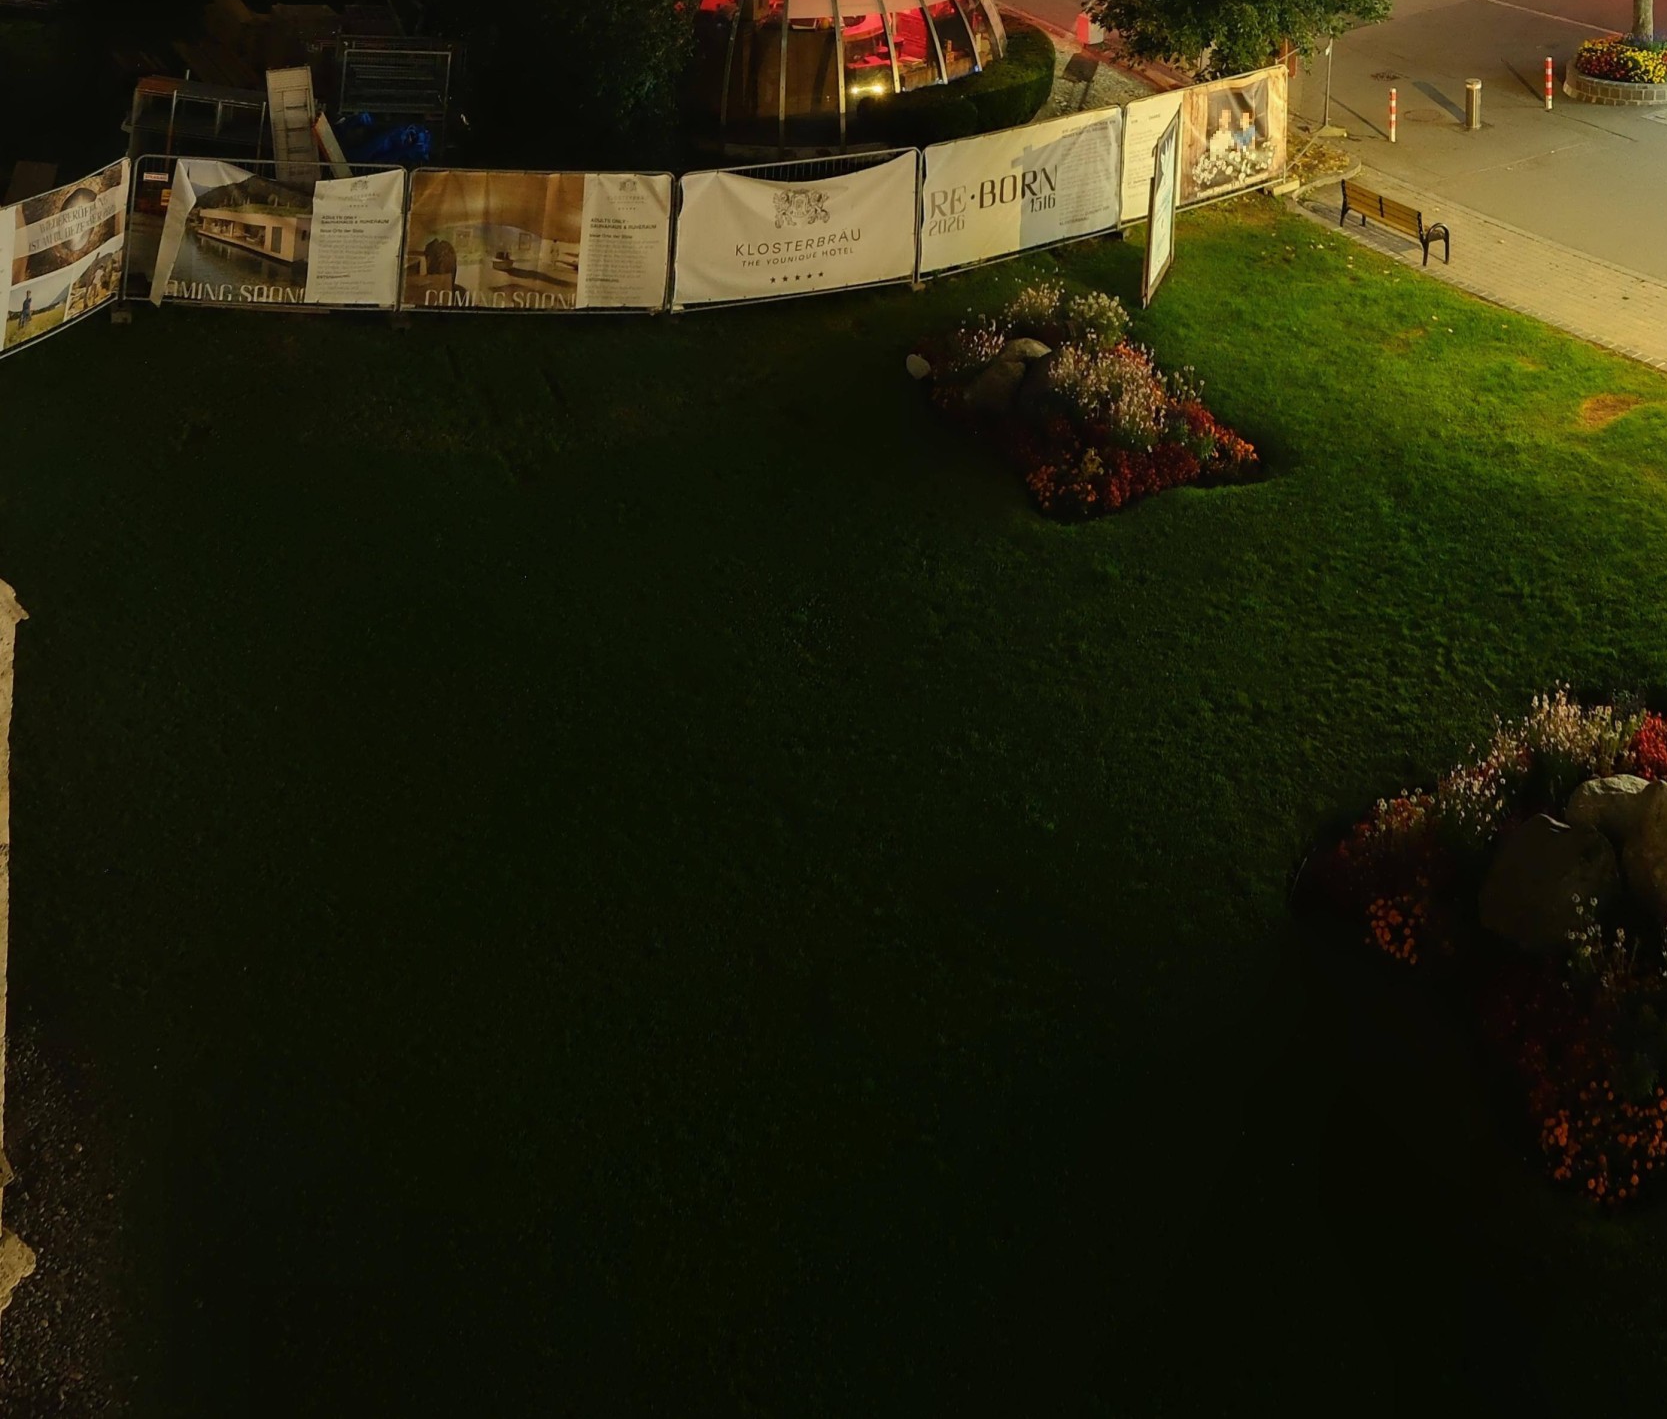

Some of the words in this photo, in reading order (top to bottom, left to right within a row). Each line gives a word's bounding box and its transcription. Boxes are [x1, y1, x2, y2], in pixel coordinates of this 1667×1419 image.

[1029, 193, 1057, 214] 1516
[735, 227, 862, 258] KLOSTERBRÄU
[742, 259, 761, 268] THE
[766, 251, 818, 266] YOUNIQUE
[821, 247, 855, 258] HOTEL
